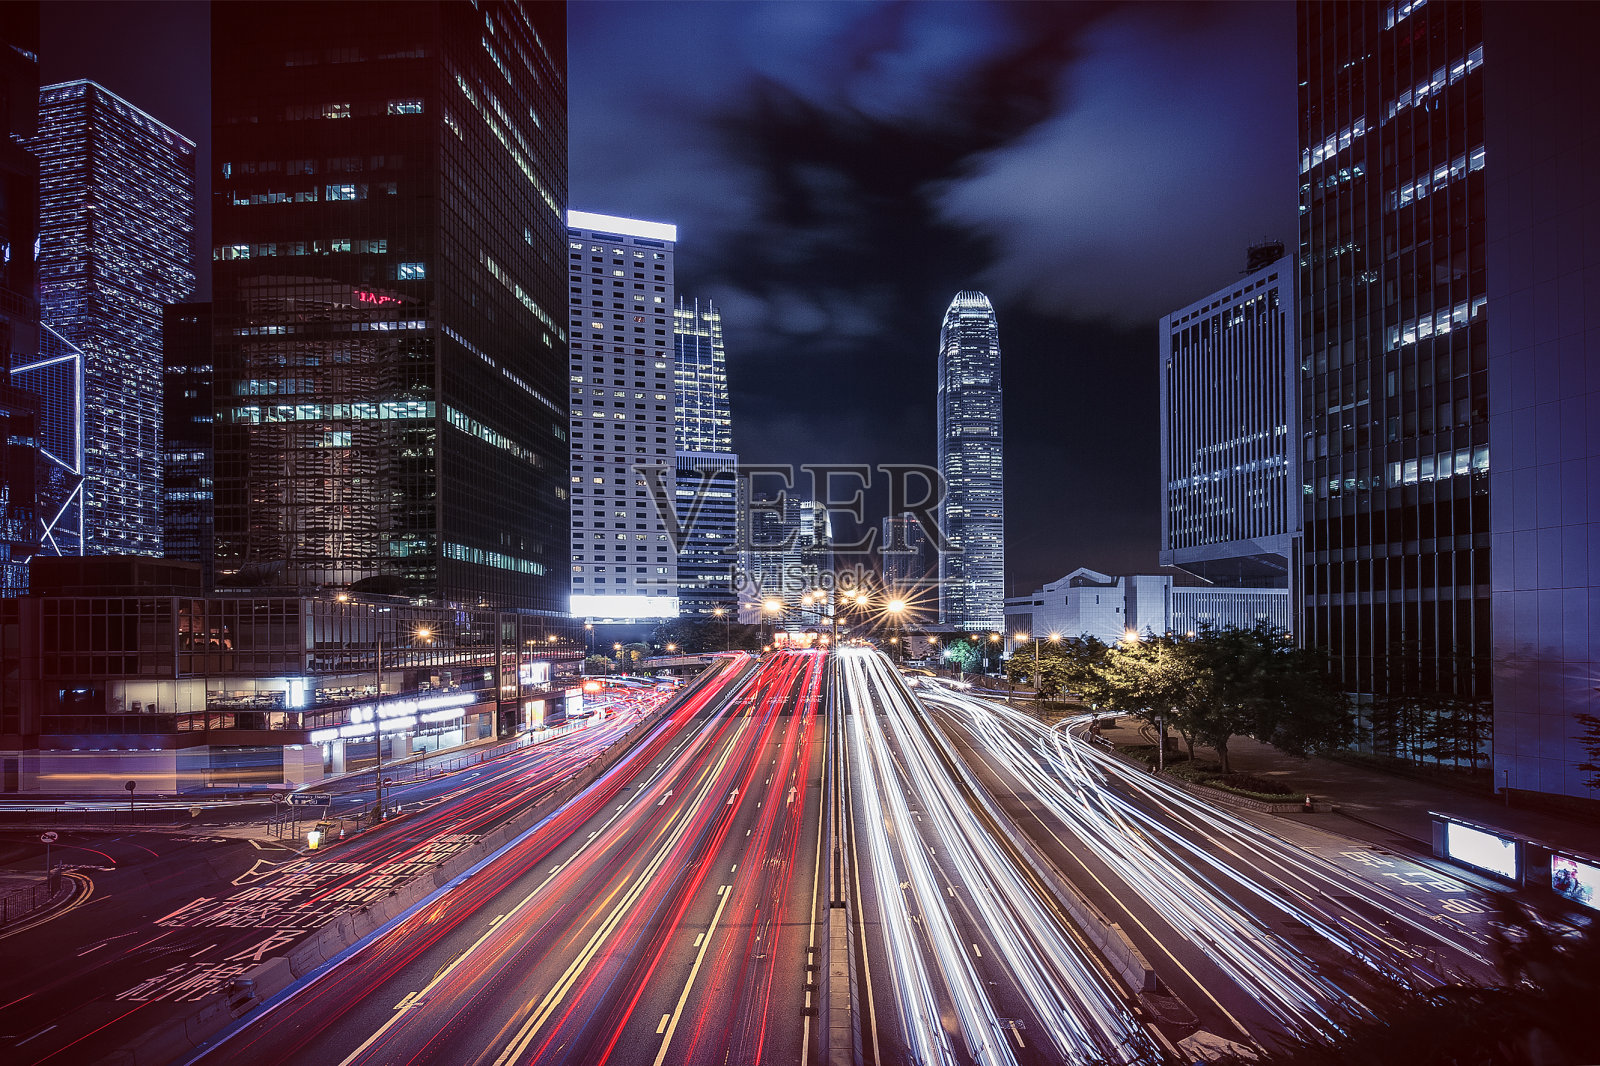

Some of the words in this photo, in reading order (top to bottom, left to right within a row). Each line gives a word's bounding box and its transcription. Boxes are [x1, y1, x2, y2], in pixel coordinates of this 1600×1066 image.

[281, 862, 371, 874] COTTON
[265, 874, 338, 886] TREE
[1382, 872, 1466, 893] 巴士
[225, 887, 315, 901] DRIVE
[319, 888, 392, 902] DRIV
[1437, 898, 1504, 914] TOP
[223, 929, 307, 961] 及
